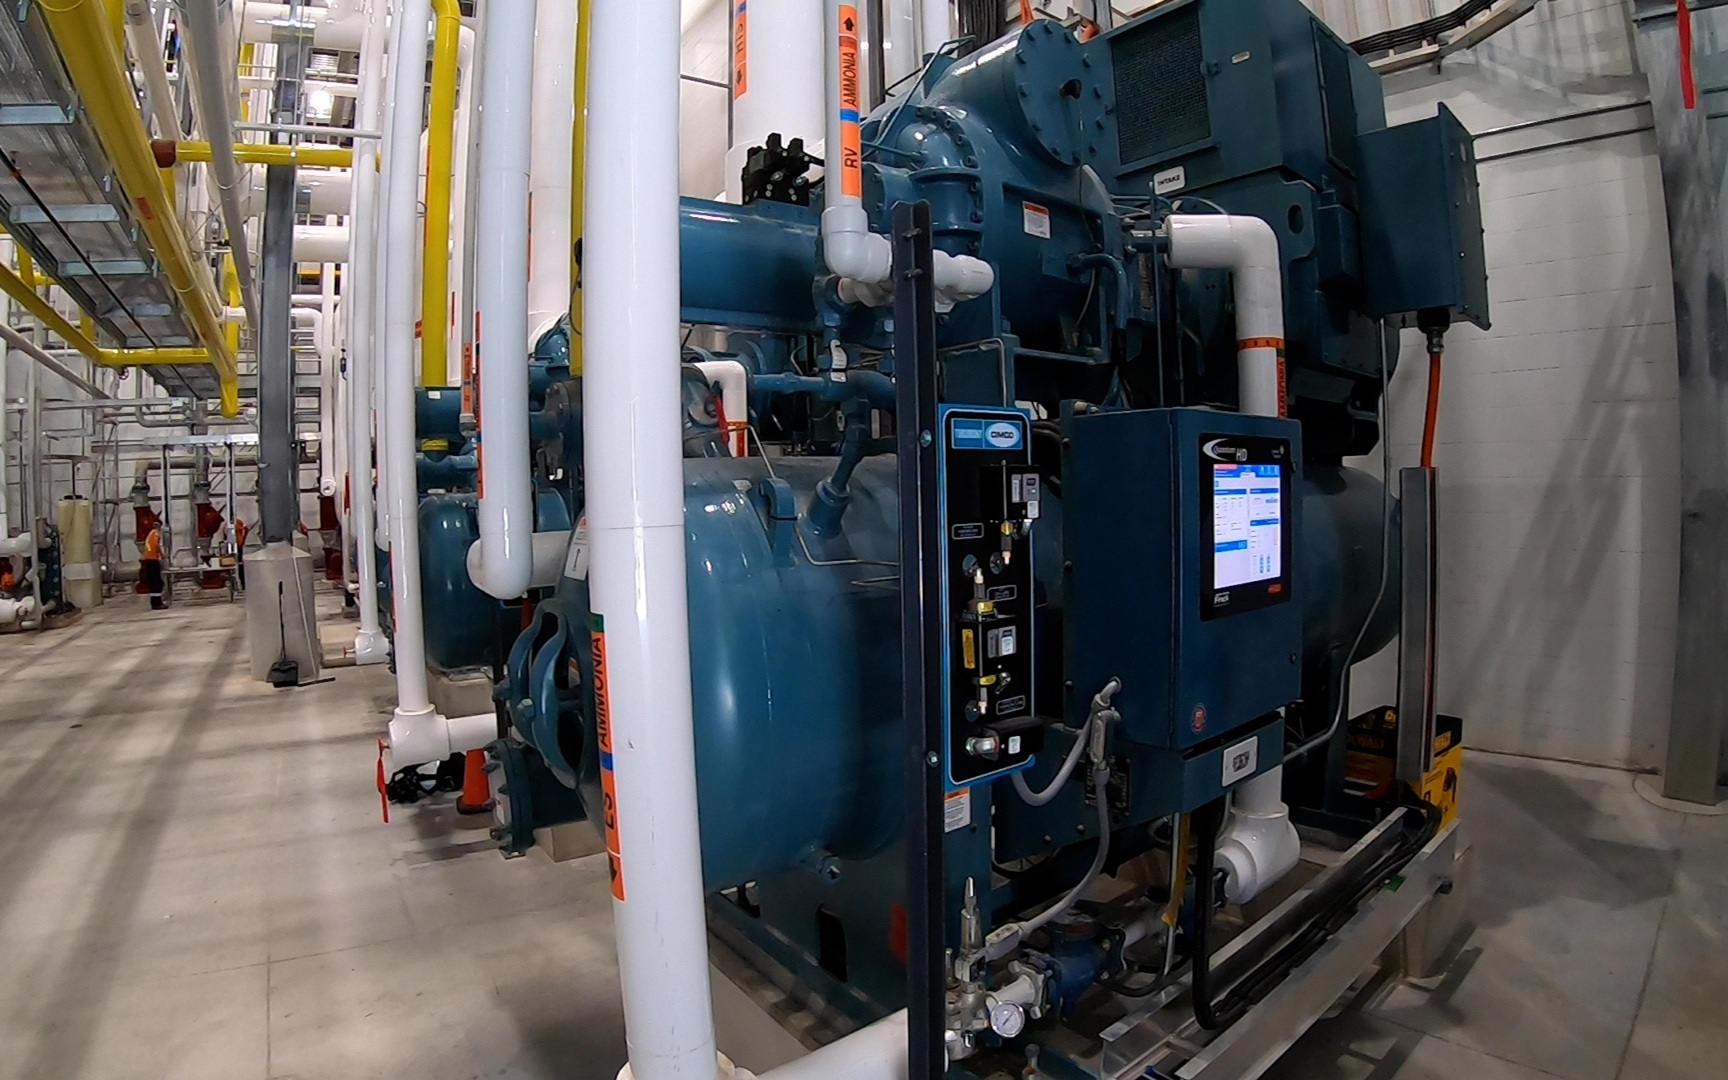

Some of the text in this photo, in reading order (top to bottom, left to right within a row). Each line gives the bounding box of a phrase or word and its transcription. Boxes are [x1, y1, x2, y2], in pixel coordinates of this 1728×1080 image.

[843, 51, 857, 108] AMMONIA
[844, 147, 858, 169] RV
[1157, 174, 1181, 186] INTAKE
[990, 431, 1015, 439] CIMCO
[1236, 448, 1248, 462] HD
[592, 637, 608, 748] AMMONIA
